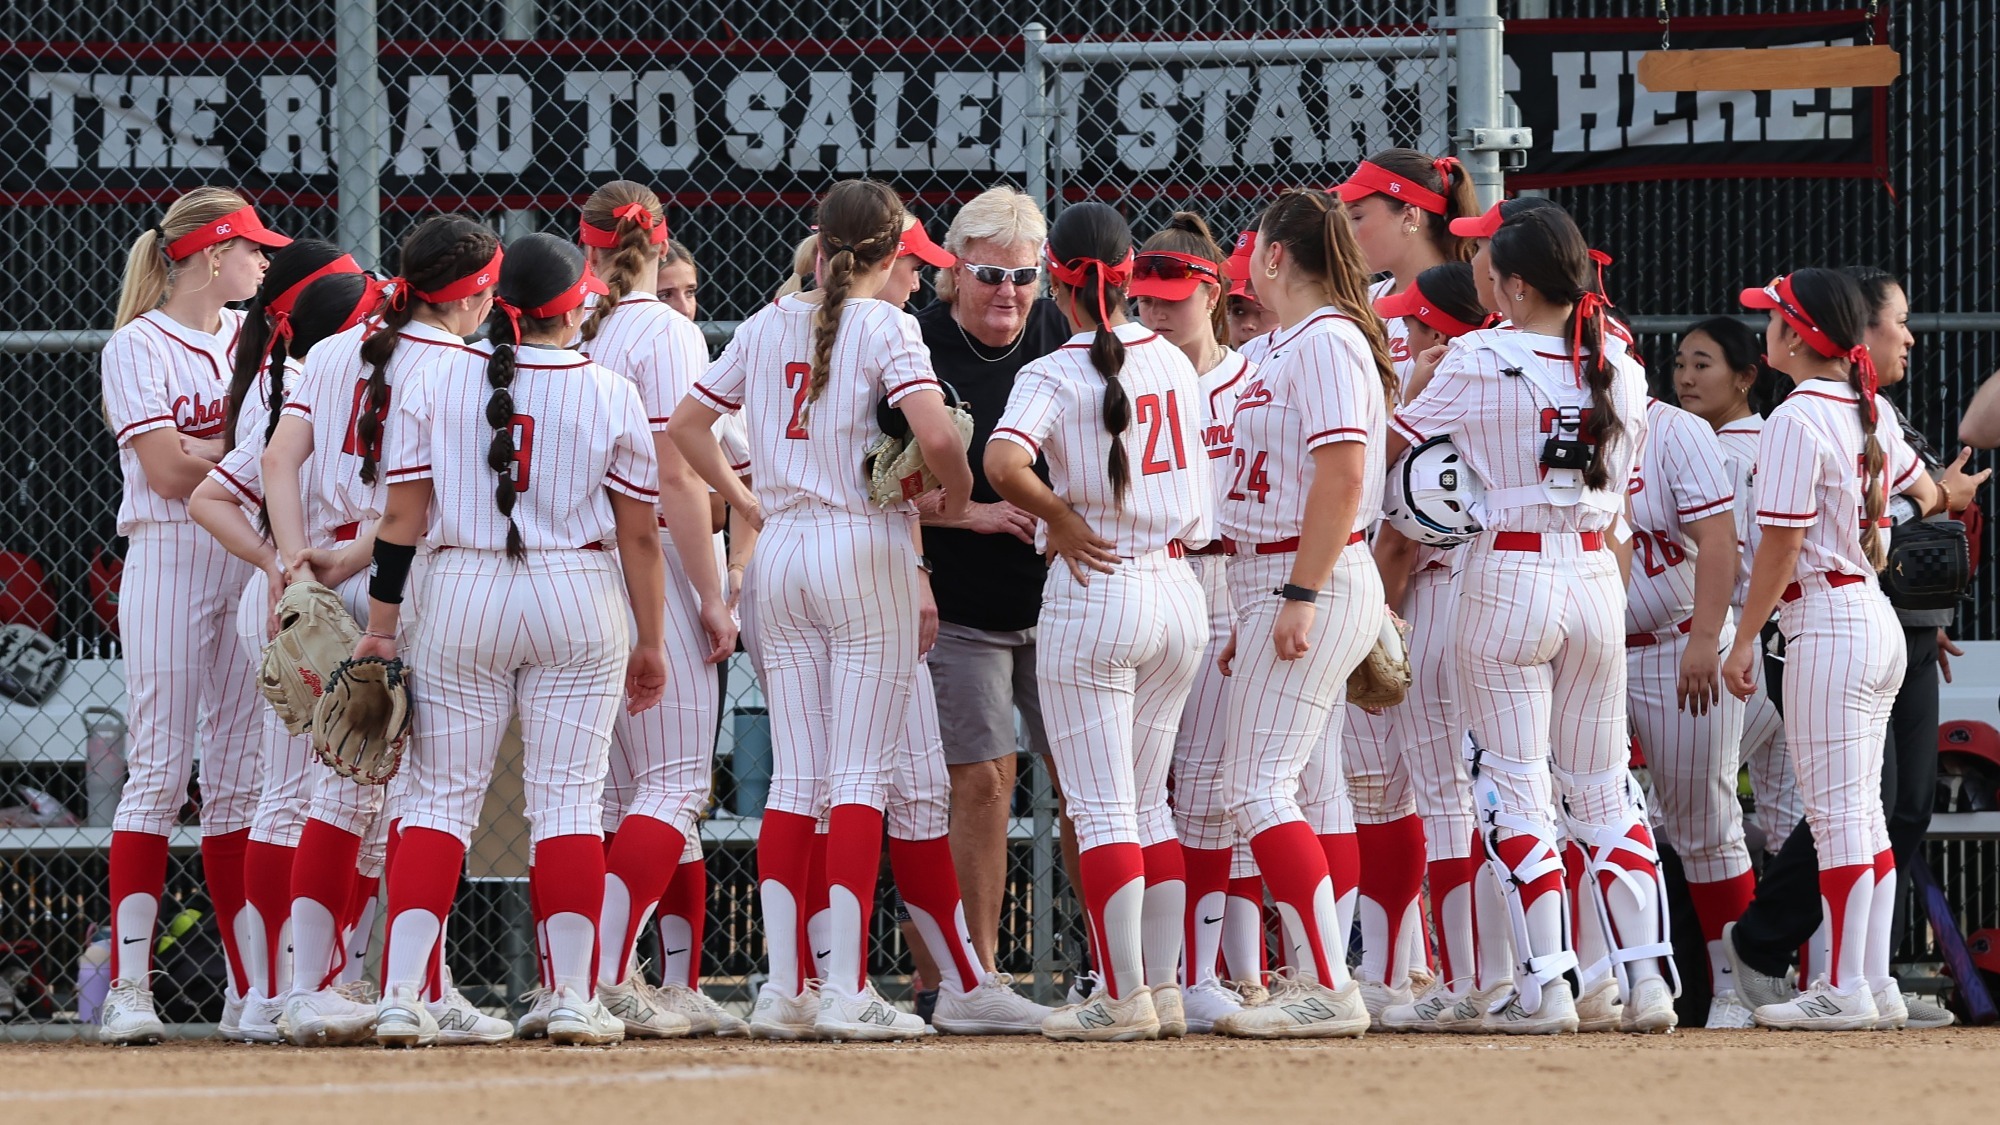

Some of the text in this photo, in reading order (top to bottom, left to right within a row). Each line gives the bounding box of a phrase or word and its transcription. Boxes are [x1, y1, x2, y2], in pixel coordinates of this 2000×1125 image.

[28, 71, 230, 169] THE
[564, 69, 700, 172] TO
[1389, 181, 1401, 193] 15
[216, 223, 232, 235] GC
[476, 273, 491, 286] GC
[1419, 306, 1430, 316] 17
[785, 361, 812, 440] 2
[1136, 389, 1187, 476] 21
[1228, 448, 1271, 504] 24
